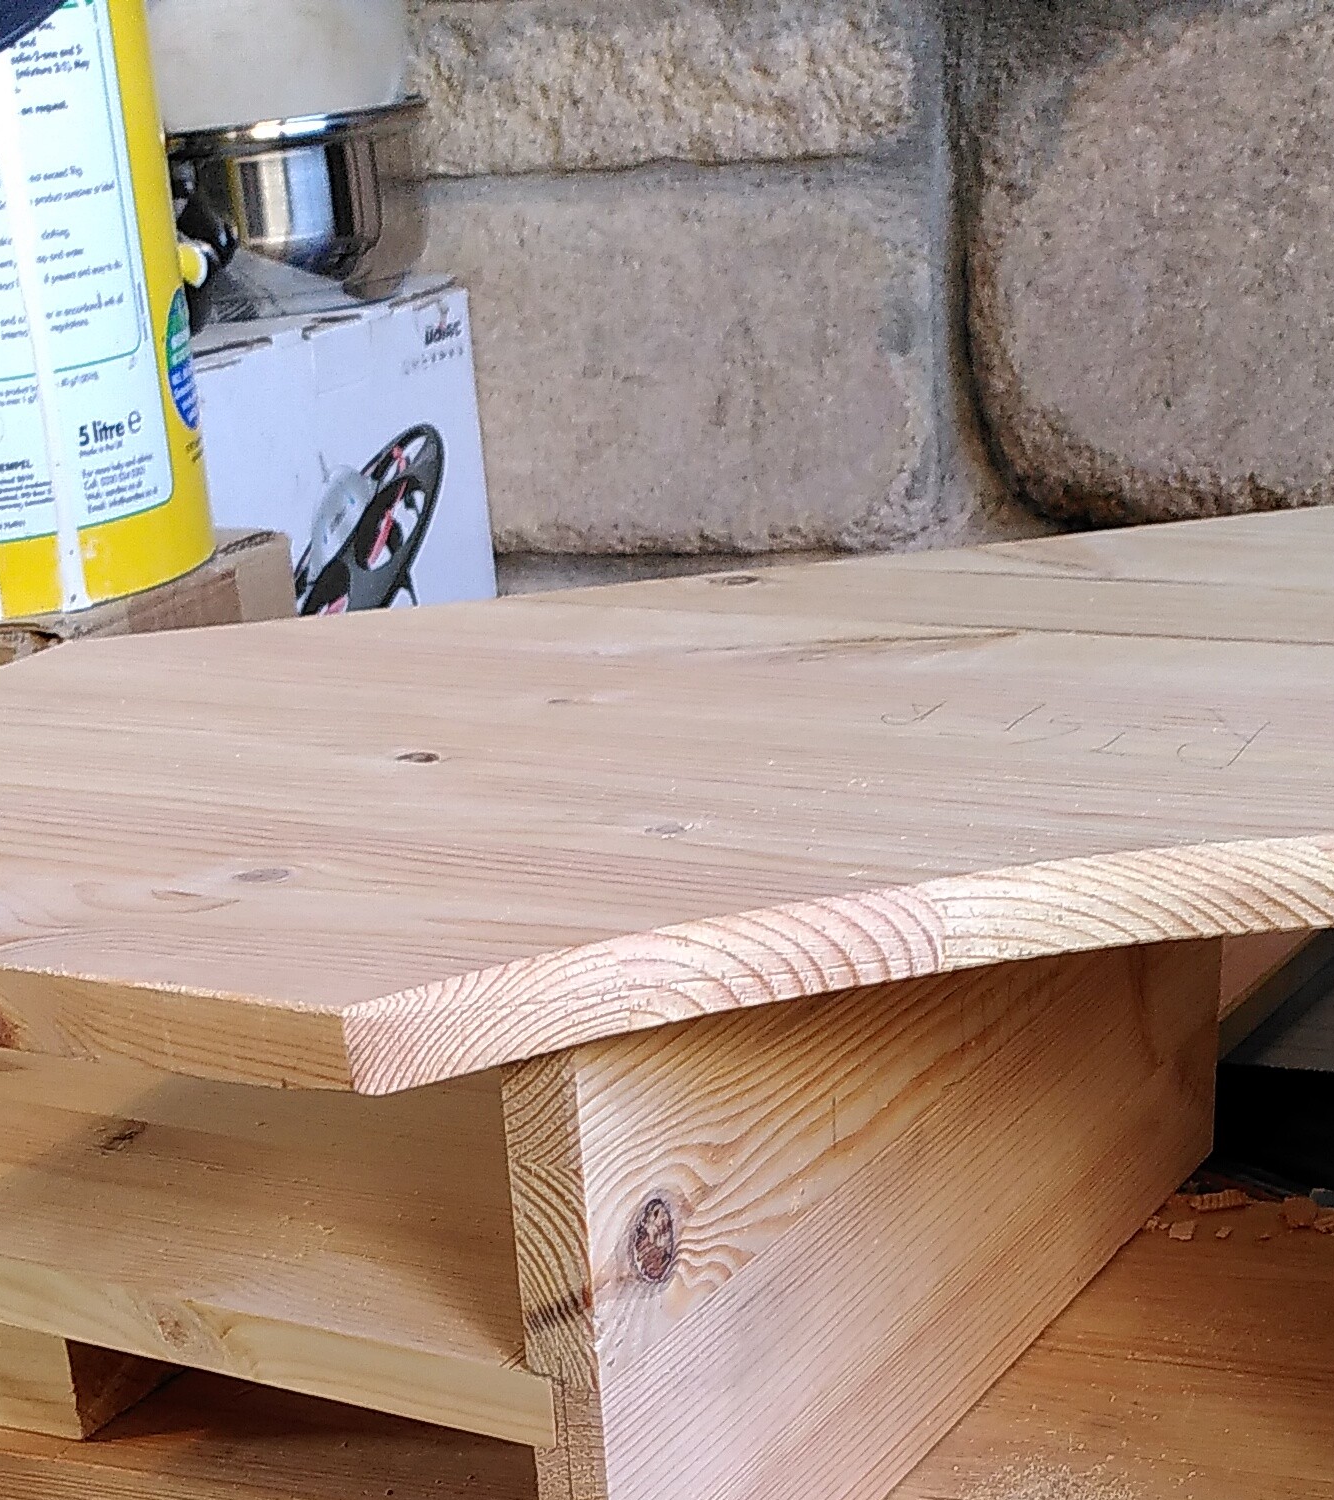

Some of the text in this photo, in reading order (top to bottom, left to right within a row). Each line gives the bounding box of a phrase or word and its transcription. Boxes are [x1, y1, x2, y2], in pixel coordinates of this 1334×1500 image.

[79, 409, 142, 447] 5 litre e
